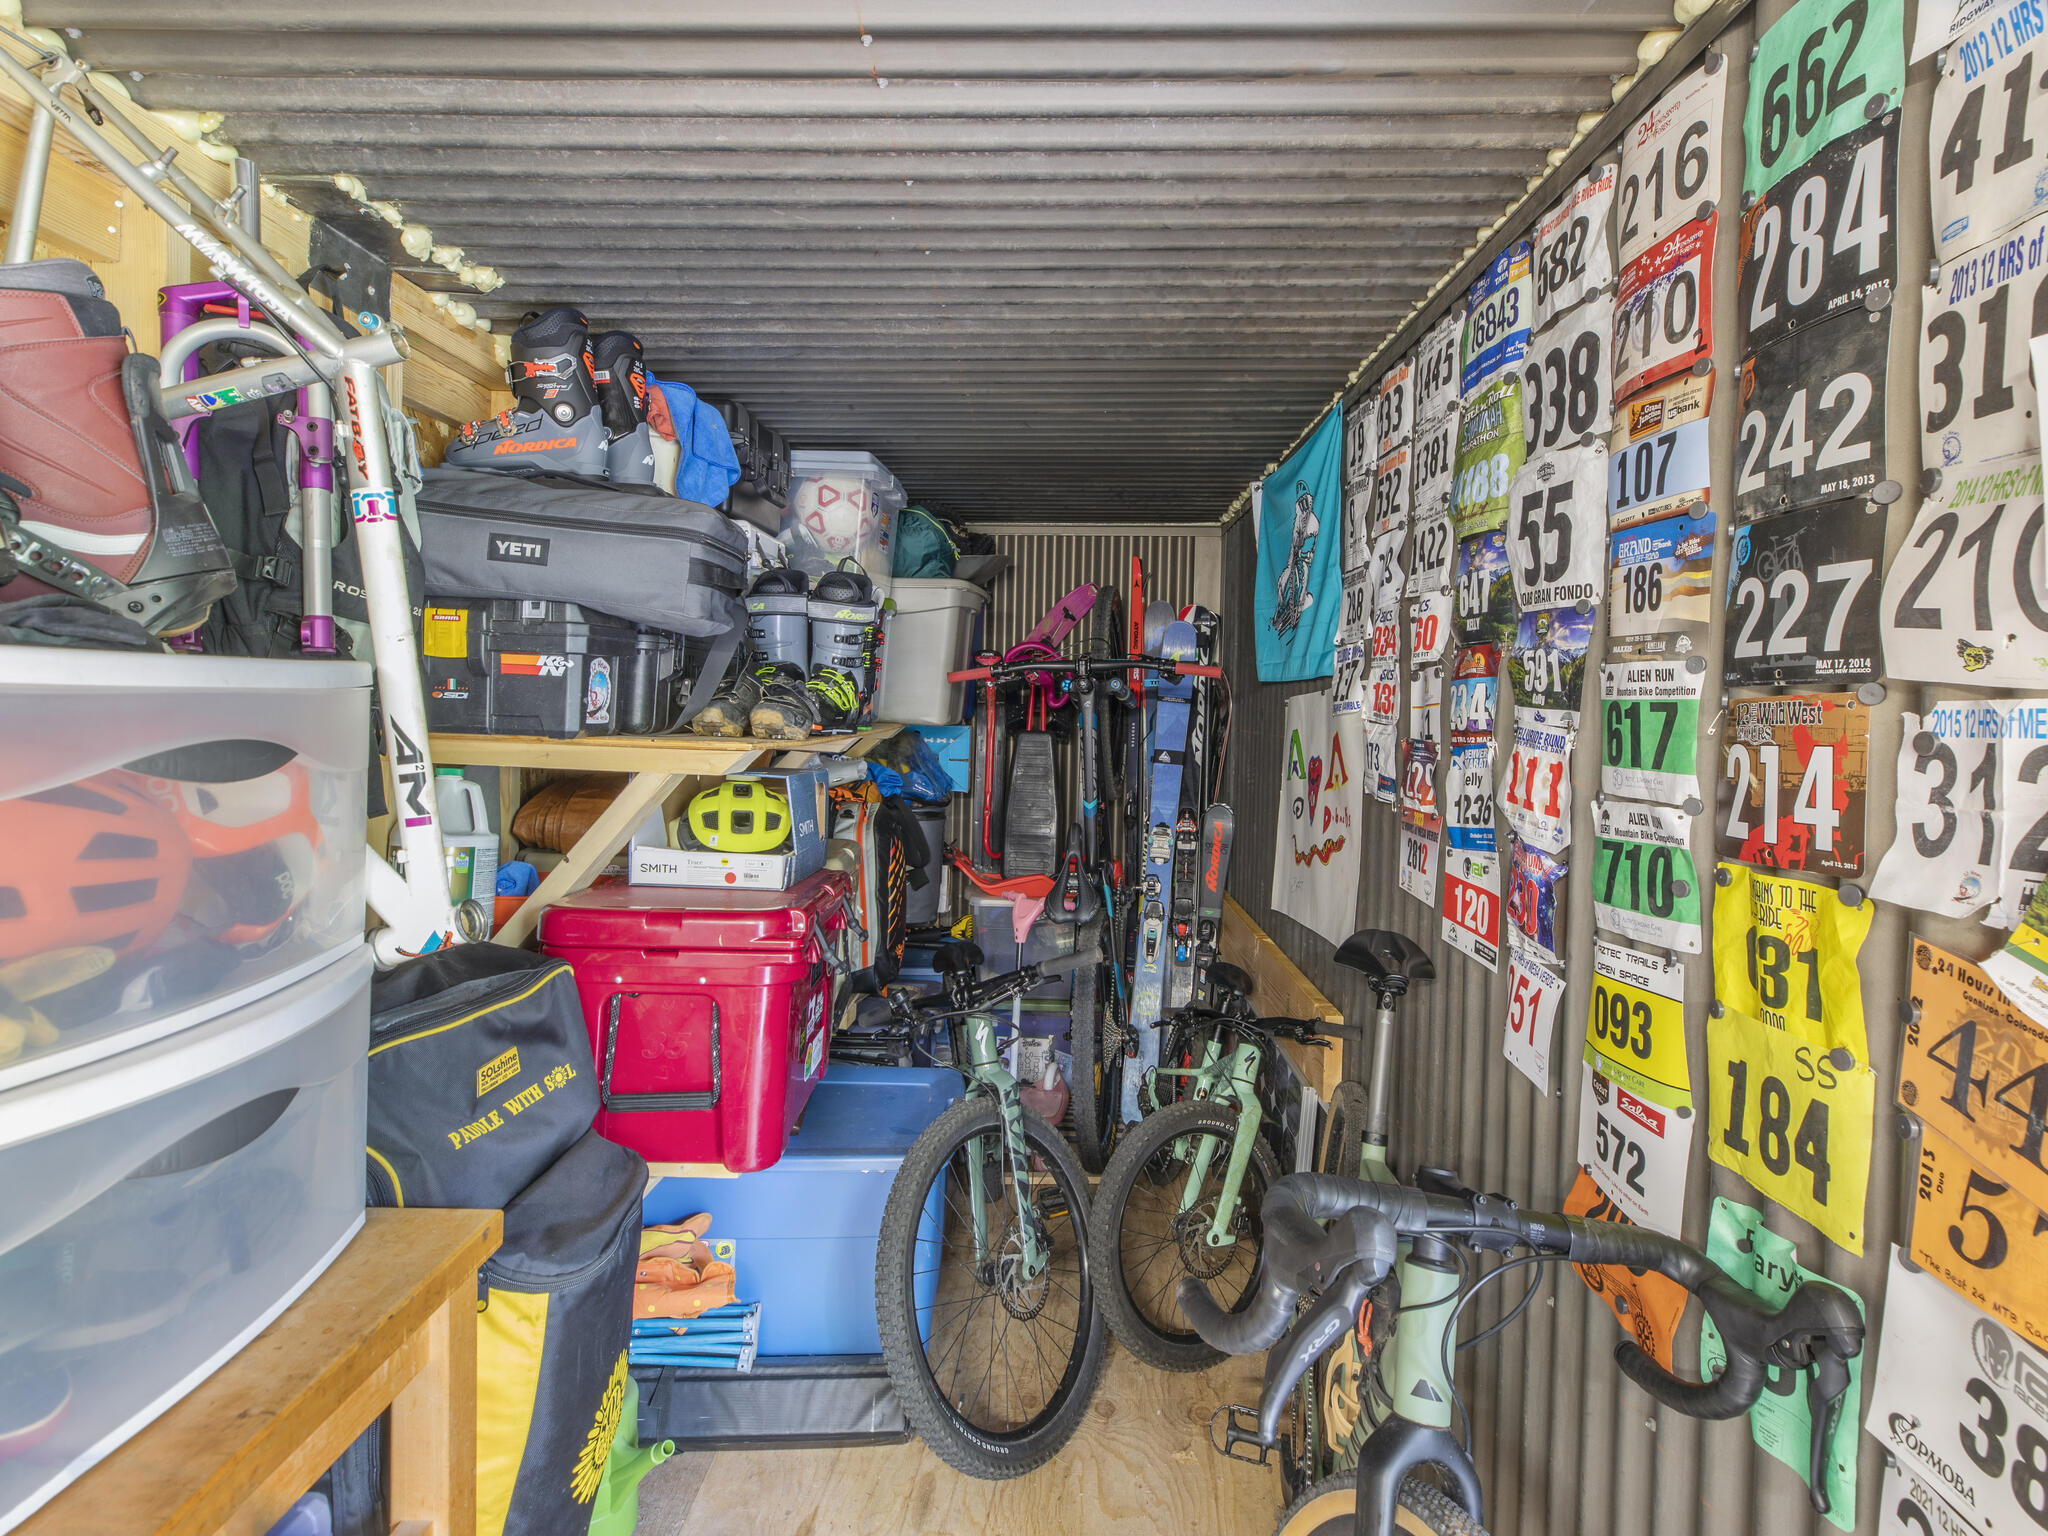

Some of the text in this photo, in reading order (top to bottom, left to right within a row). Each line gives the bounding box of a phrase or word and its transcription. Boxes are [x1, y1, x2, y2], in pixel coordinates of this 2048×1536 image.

[1959, 31, 1995, 83] 2012
[1991, 17, 2014, 61] 12
[2009, 0, 2045, 47] HRS
[1760, 0, 1869, 168] 662
[1637, 110, 1655, 149] 24
[1581, 174, 1613, 203] RIVER RIDE
[1620, 120, 1709, 250] 216
[1662, 233, 1681, 262] 24
[1750, 136, 1889, 332] 284
[1511, 263, 1528, 277] TEAM
[1538, 215, 1590, 307] 582
[1949, 226, 2046, 305] 2013 12 HRS of
[1828, 293, 1849, 310] APRIL
[1851, 288, 1864, 301] 14,
[1472, 287, 1519, 353] 16843
[1614, 270, 1697, 380] 210
[1524, 330, 1601, 459] 338
[1644, 403, 1661, 413] Grand
[493, 437, 577, 455] NORDICA
[1350, 421, 1365, 467] 19
[1462, 429, 1500, 454] MARATHON
[1737, 372, 1872, 496] 242
[1415, 428, 1449, 490] 1381
[1616, 430, 1677, 509] 107
[1376, 467, 1402, 522] 532
[1821, 474, 1875, 494] MAY 18, 2013
[1948, 478, 1978, 510] 2014
[1978, 474, 1993, 505] 12
[1989, 468, 2021, 502] HRS
[496, 540, 541, 557] YETI
[1411, 522, 1447, 575] 1422
[1518, 480, 1574, 586] 55
[1619, 537, 1651, 558] GRAND
[1460, 570, 1490, 617] 647
[1534, 583, 1593, 605] GRAN FONDO
[1623, 561, 1663, 614] 186
[1735, 559, 1873, 659] 227
[1373, 624, 1397, 657] 934
[1523, 649, 1562, 692] 591
[1627, 668, 1674, 682] ALIEN RUN
[1815, 658, 1871, 670] MAY 17, 2014
[1639, 687, 1653, 696] Bike
[1655, 686, 1696, 697] Competition
[1758, 701, 1786, 726] Wild
[1788, 701, 1823, 726] West
[1932, 709, 1963, 738] 2015
[1965, 709, 1976, 738] 12
[1977, 709, 1998, 738] HRS
[1550, 747, 1562, 755] DAY
[1607, 700, 1678, 770] 617
[1507, 752, 1562, 818] 111
[1725, 744, 1840, 852] 214
[799, 819, 814, 837] SMITH
[1454, 794, 1492, 826] 1236
[1629, 812, 1649, 826] ALIEN
[1615, 827, 1638, 838] Mountain
[1640, 831, 1653, 841] Bike
[640, 863, 677, 874] SMITH
[1205, 821, 1224, 893] NORDICA
[1407, 837, 1428, 875] 2812
[1821, 859, 1833, 867] April
[1602, 840, 1674, 918] 710
[1779, 884, 1816, 913] TO THE
[1455, 884, 1489, 935] 120
[1508, 865, 1539, 935] 230
[1758, 904, 1782, 930] RIDE
[1540, 967, 1555, 989] VERDE
[1598, 961, 1649, 987] OPEN SPACE
[1626, 953, 1658, 970] TRAILS
[1958, 969, 1993, 996] Hours
[1595, 986, 1653, 1060] 093
[1907, 995, 1924, 1048] 202
[1963, 990, 2000, 1017] Gunnison
[1795, 1047, 1837, 1089] SS
[448, 1083, 545, 1150] PADDLE WITH
[1198, 1119, 1225, 1130] GROUND
[1620, 1098, 1659, 1132] Salsa
[1724, 1060, 1831, 1206] 184
[1596, 1112, 1645, 1197] 572
[1919, 1148, 1936, 1202] 2013
[1937, 1172, 1945, 1194] Duo
[1638, 1203, 1649, 1216] Earth
[1919, 1249, 2018, 1324] The Best 24 MTB
[1300, 1319, 1340, 1363] GRX
[982, 1442, 1009, 1454] GROUND
[1910, 1478, 1949, 1533] 2021 12
